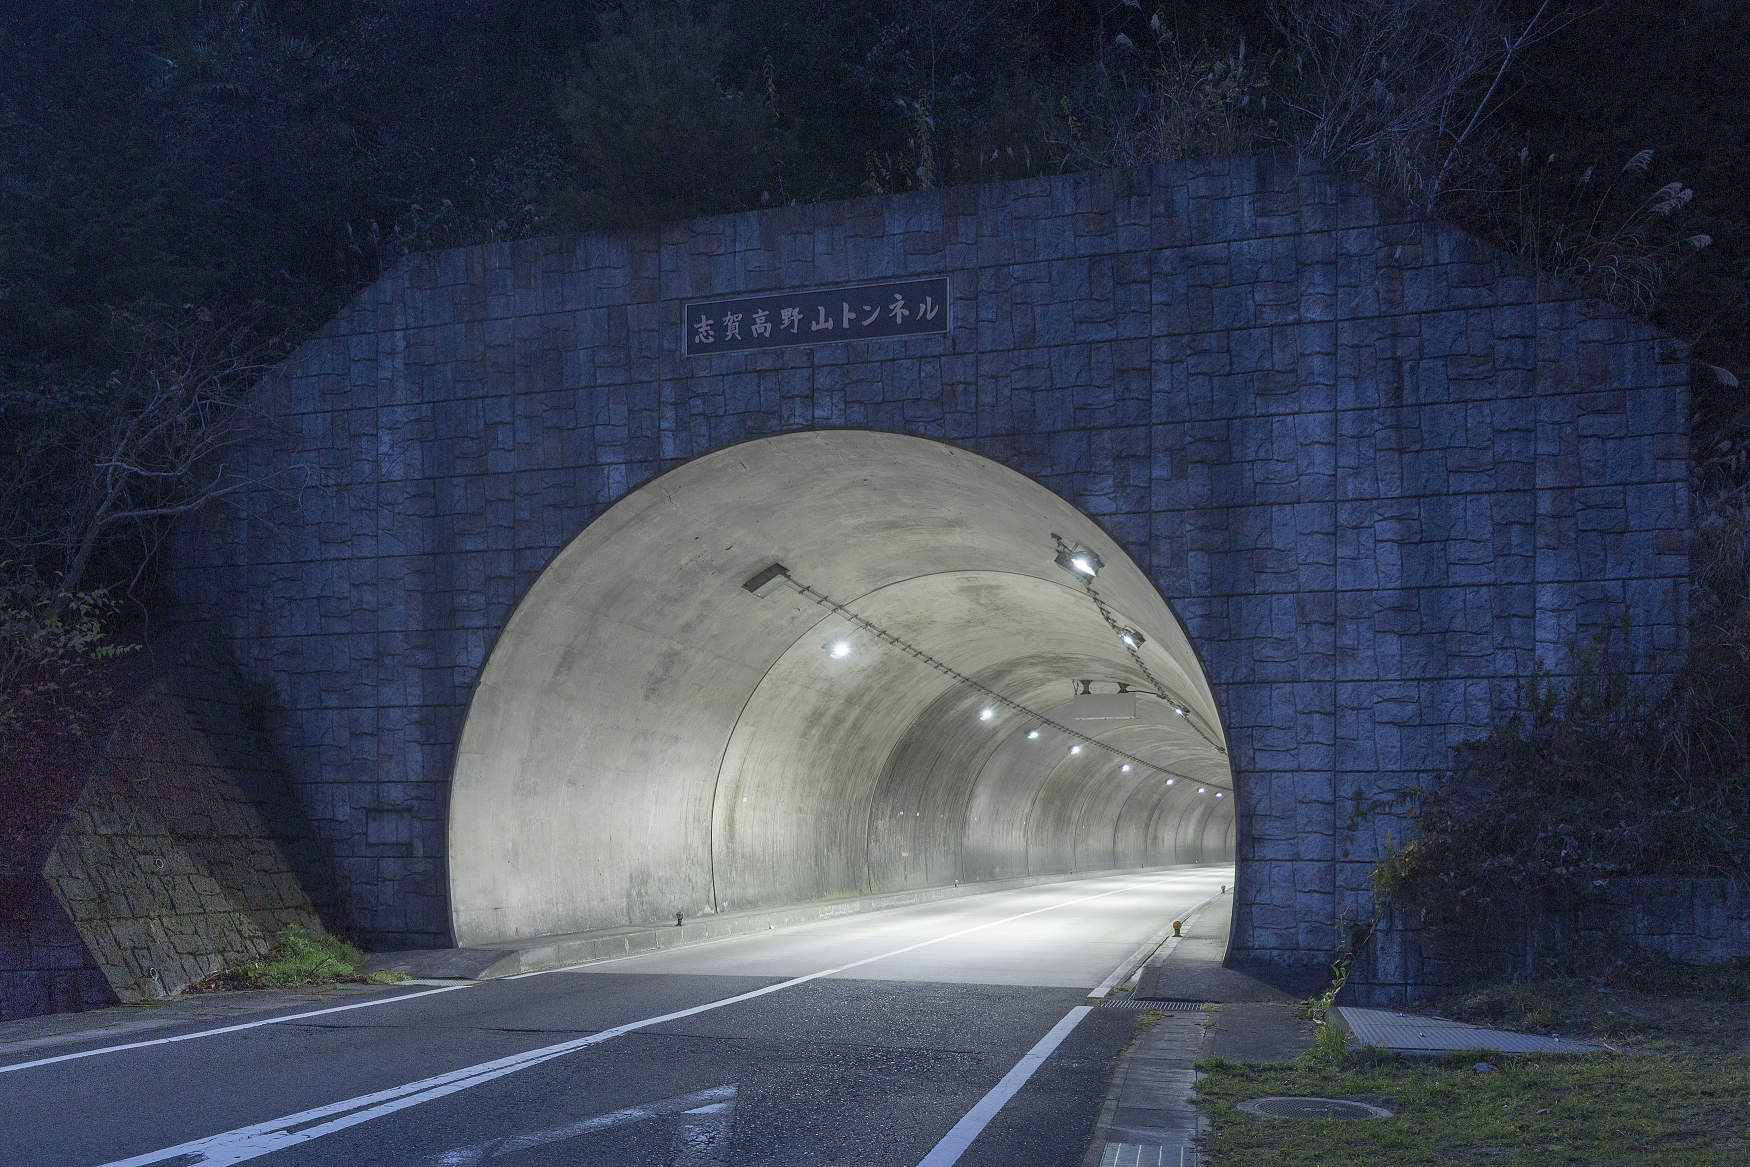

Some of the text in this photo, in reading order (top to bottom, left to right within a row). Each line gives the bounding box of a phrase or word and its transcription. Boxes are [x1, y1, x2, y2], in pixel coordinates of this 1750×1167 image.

[694, 293, 939, 344] 志賀高野山トンネル
